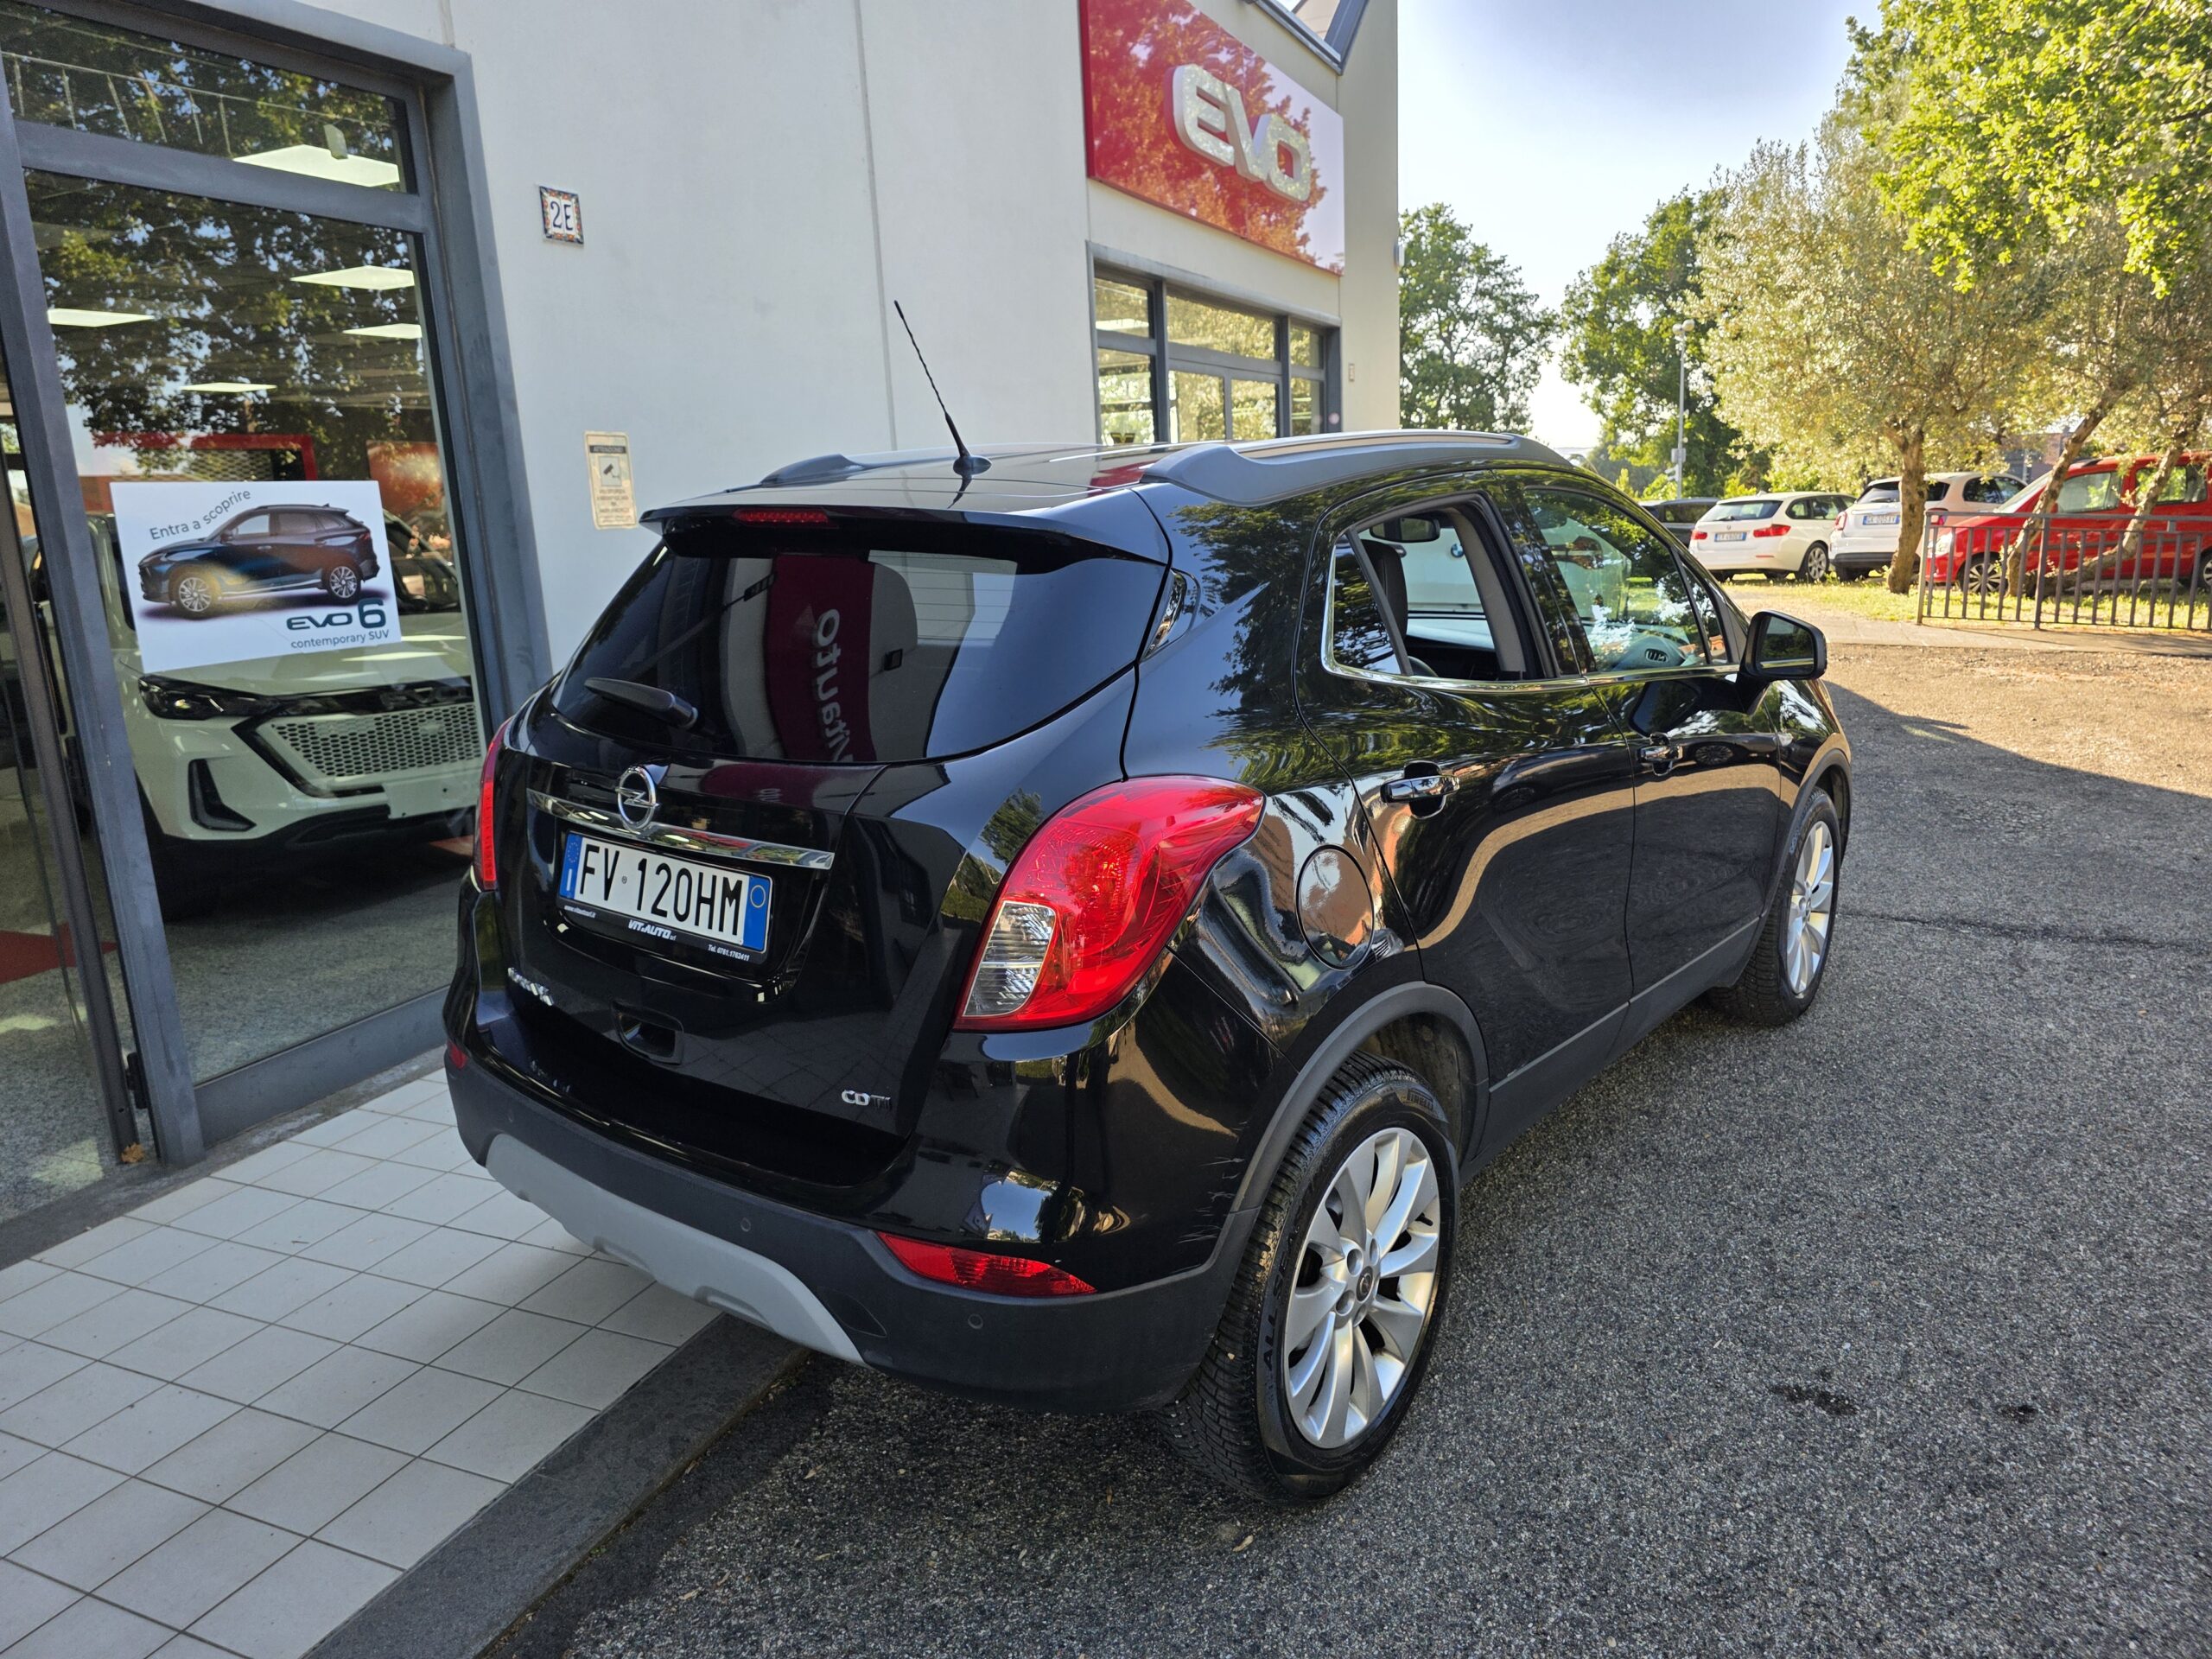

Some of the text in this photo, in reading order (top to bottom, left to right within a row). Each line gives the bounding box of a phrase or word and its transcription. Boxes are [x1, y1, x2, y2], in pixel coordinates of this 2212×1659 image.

[1172, 63, 1312, 202] EVO
[550, 200, 575, 232] 2E
[149, 488, 251, 541] Entra a scoprire
[286, 597, 387, 631] EVO 6
[290, 629, 391, 649] contemporary SUV
[579, 843, 620, 902] FV
[636, 857, 743, 937] 120HM
